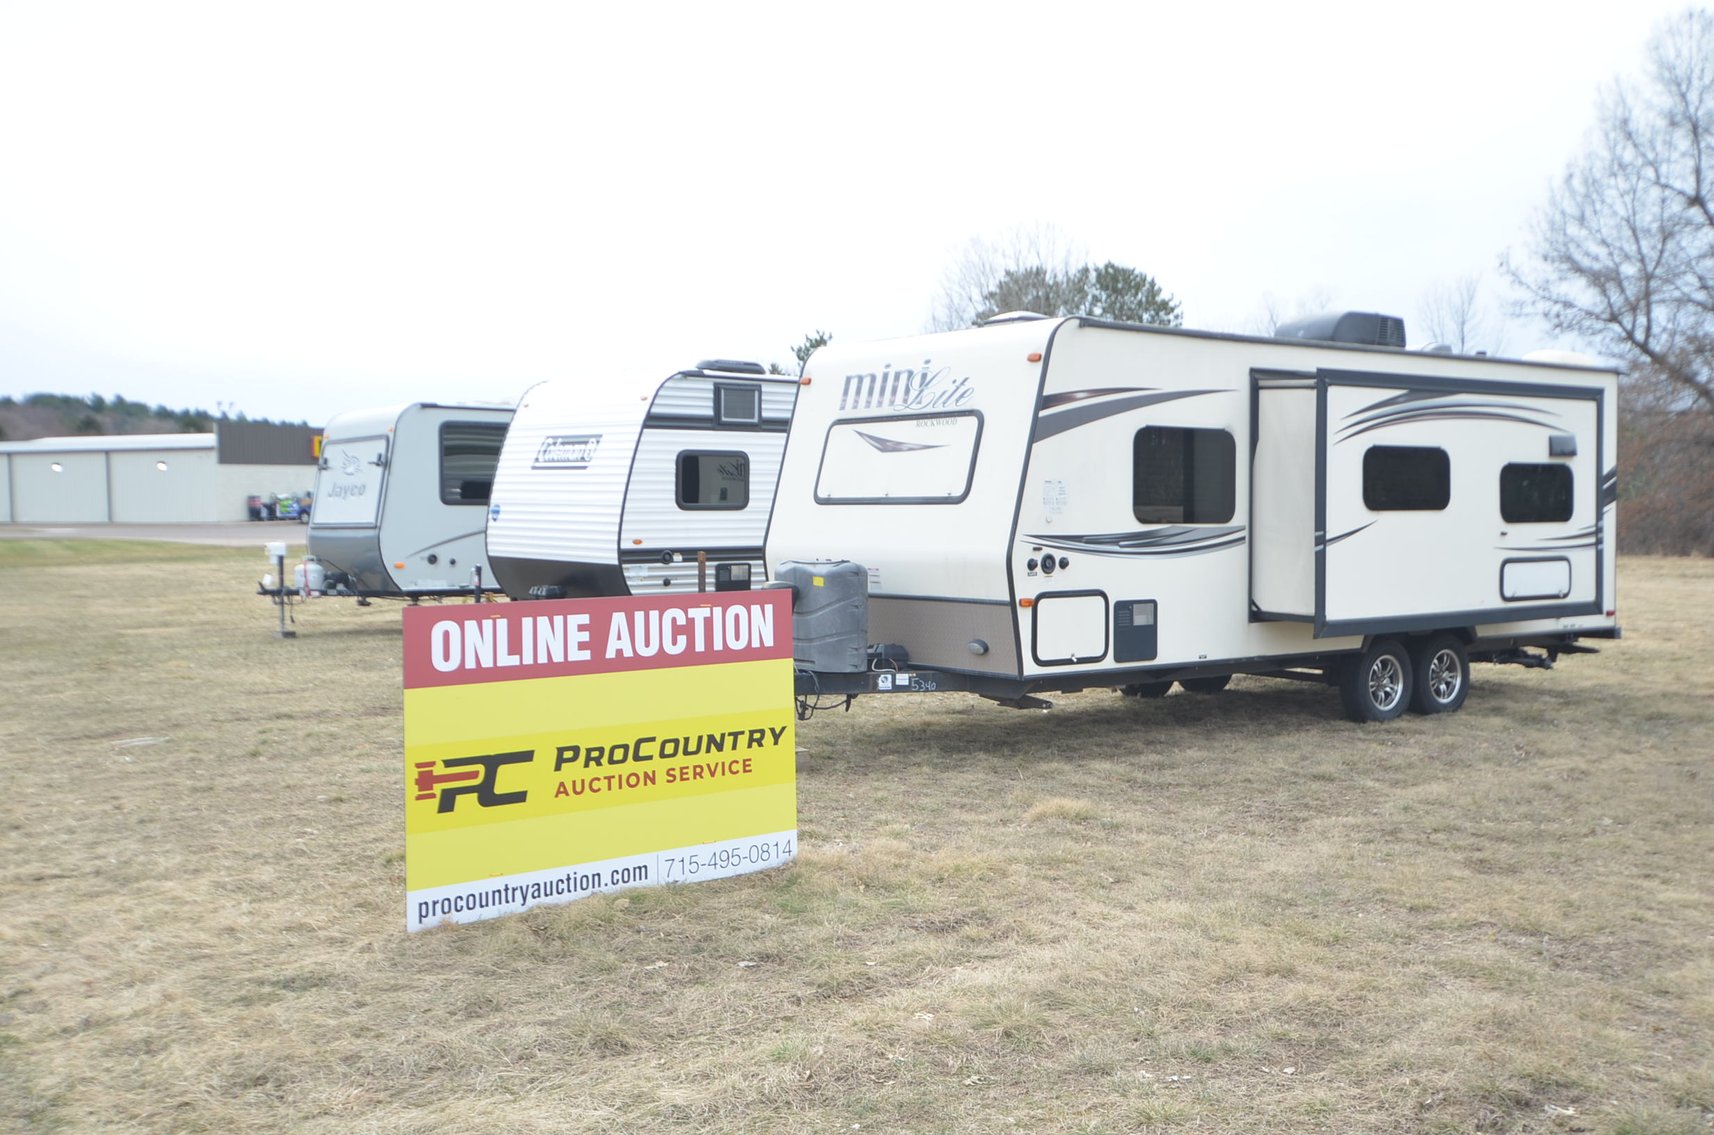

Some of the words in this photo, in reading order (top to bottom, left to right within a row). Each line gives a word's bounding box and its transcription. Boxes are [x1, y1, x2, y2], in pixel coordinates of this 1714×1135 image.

[838, 359, 931, 411] mini
[893, 366, 975, 411] Lite
[914, 418, 958, 428] ROCKWOOD
[327, 482, 366, 501] Jayco
[430, 613, 591, 672] ONLINE
[605, 603, 774, 659] AUCTION
[911, 677, 937, 691] 5340
[554, 769, 657, 798] AUCTION
[665, 757, 753, 784] SERVICE
[417, 861, 649, 924] procountryauction.com
[664, 839, 793, 879] 715-495-0814
